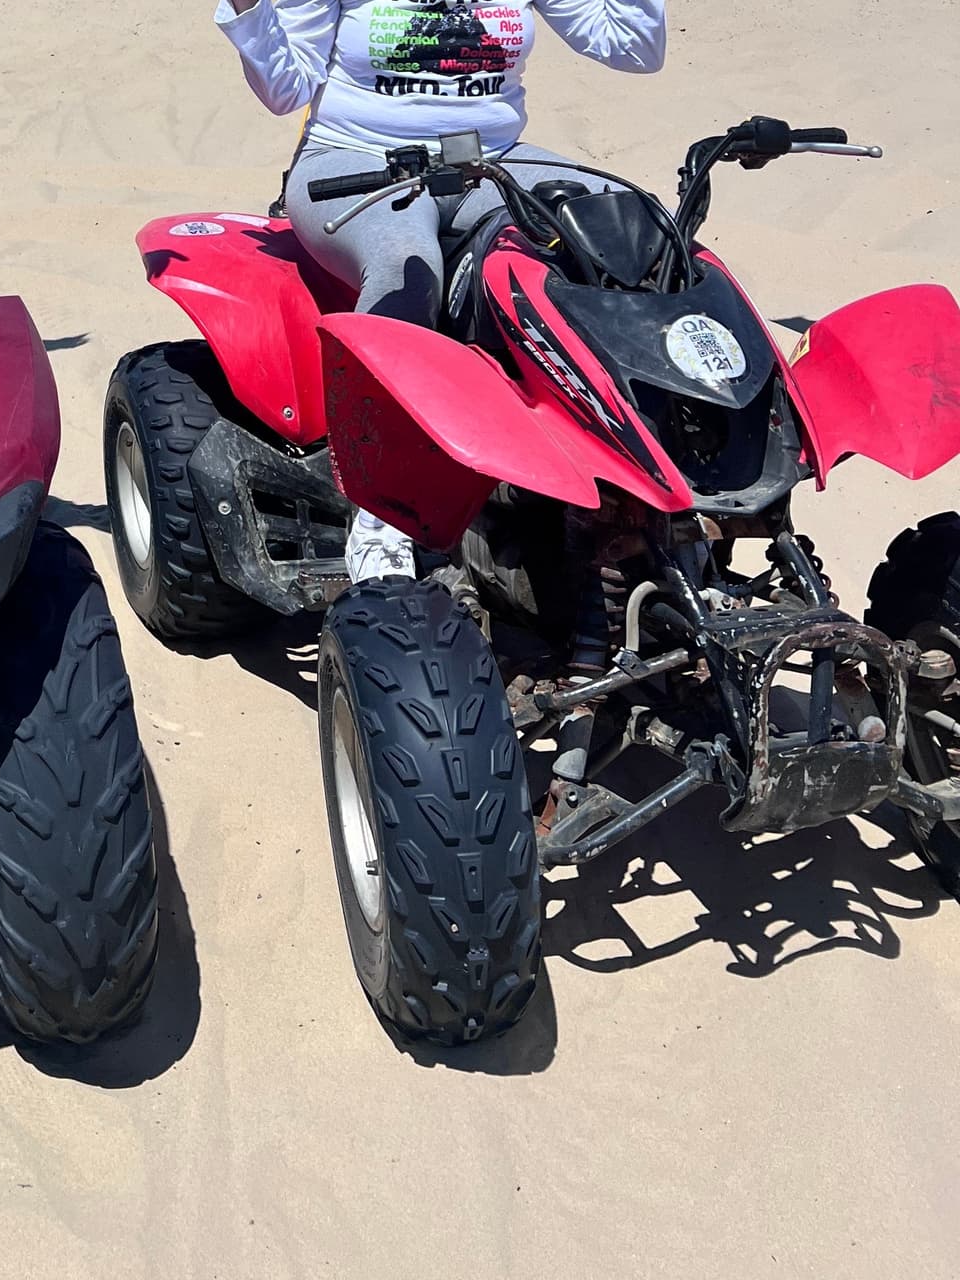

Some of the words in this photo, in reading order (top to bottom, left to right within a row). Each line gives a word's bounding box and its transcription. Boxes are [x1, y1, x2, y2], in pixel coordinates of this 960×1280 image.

[474, 6, 521, 19] Rockies
[369, 19, 412, 30] French
[499, 20, 524, 34] Alps
[369, 33, 439, 46] Californian
[480, 33, 524, 46] Sierras
[369, 46, 410, 58] Italian
[460, 47, 521, 58] Dolomites
[370, 59, 421, 71] Chinese
[453, 75, 506, 97] Tour
[681, 319, 712, 334] QA
[523, 340, 578, 399] 250EX
[701, 357, 734, 373] 121
[524, 318, 624, 431] TRX
